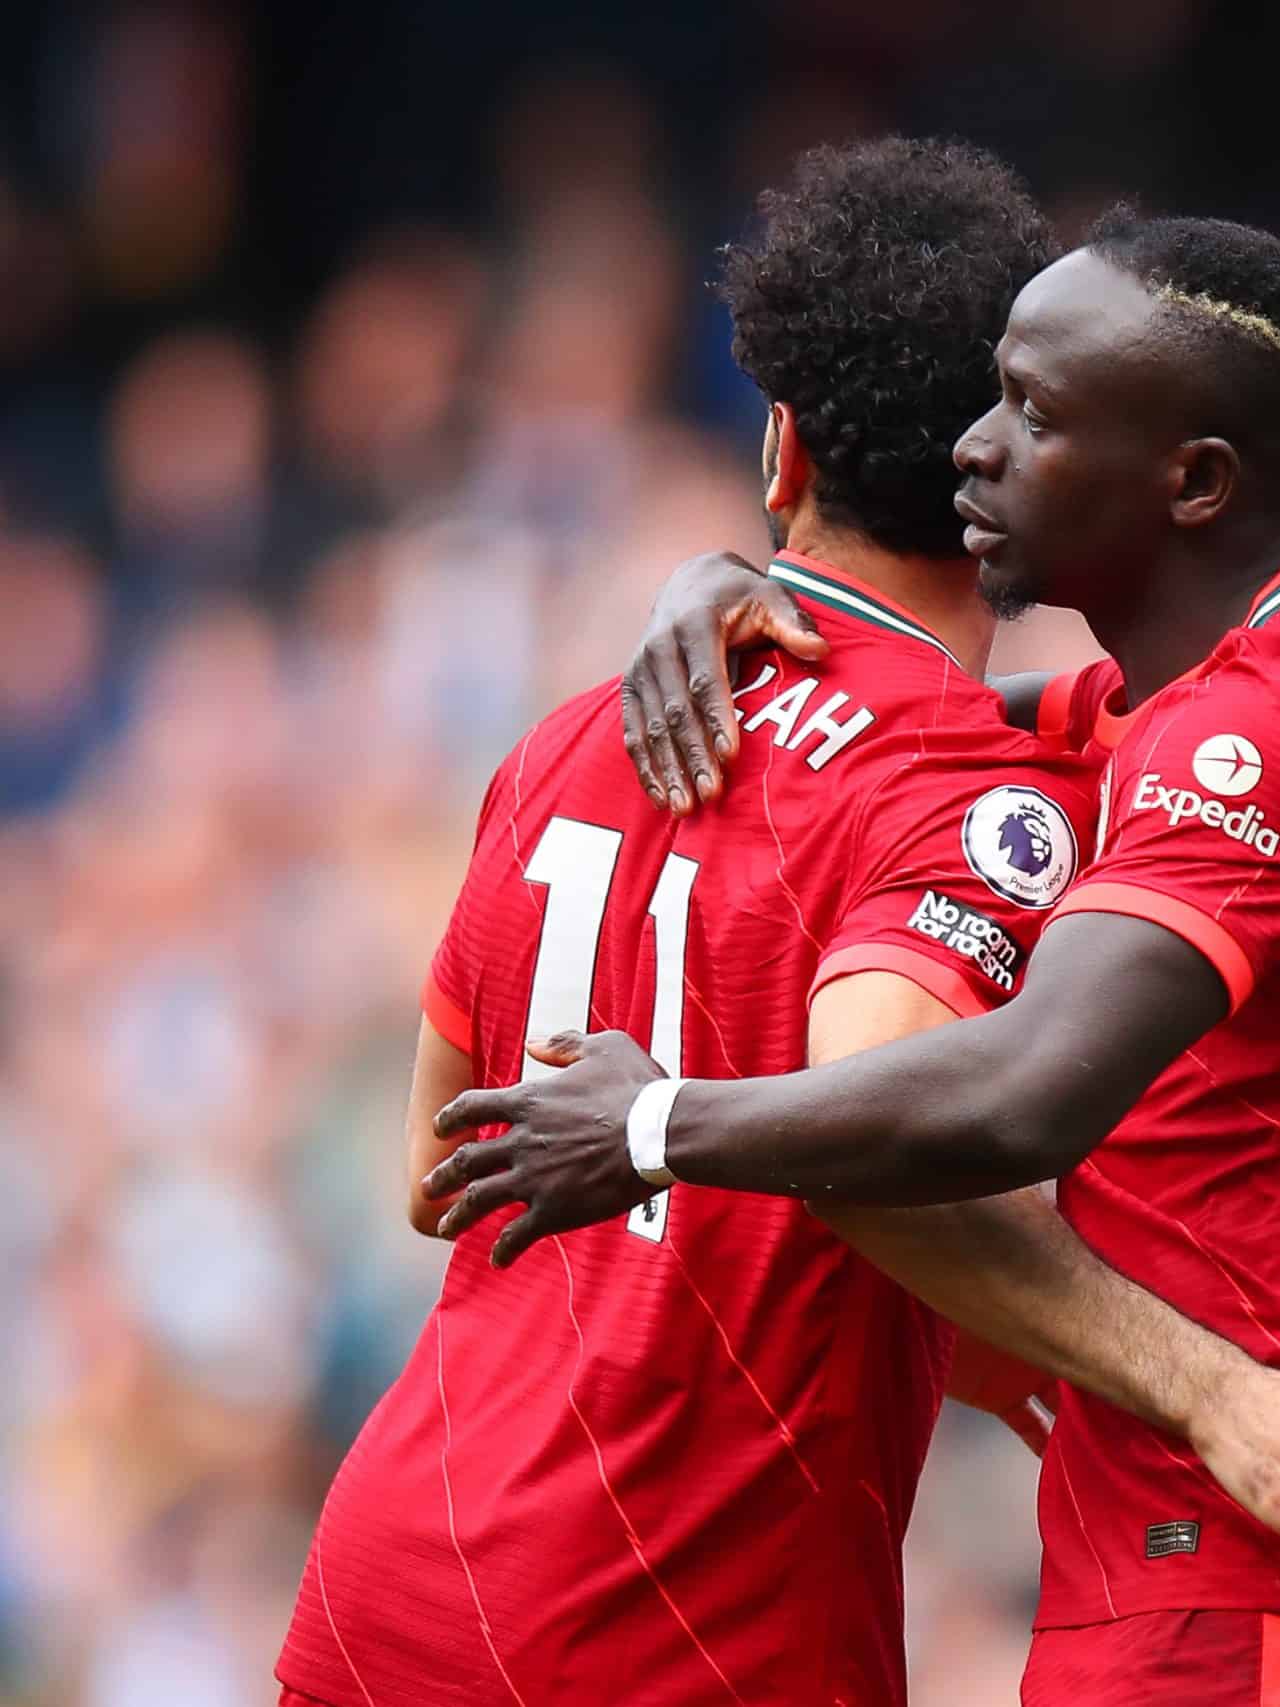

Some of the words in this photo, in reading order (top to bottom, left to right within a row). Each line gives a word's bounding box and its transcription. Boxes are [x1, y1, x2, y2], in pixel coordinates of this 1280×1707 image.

[732, 664, 876, 772] LAH
[1134, 773, 1280, 857] Expedia
[1009, 876, 1043, 894] Premier
[1043, 863, 1064, 890] League
[913, 889, 960, 925] No
[959, 912, 1017, 967] room
[946, 930, 1013, 990] racism
[523, 815, 700, 1243] 11
